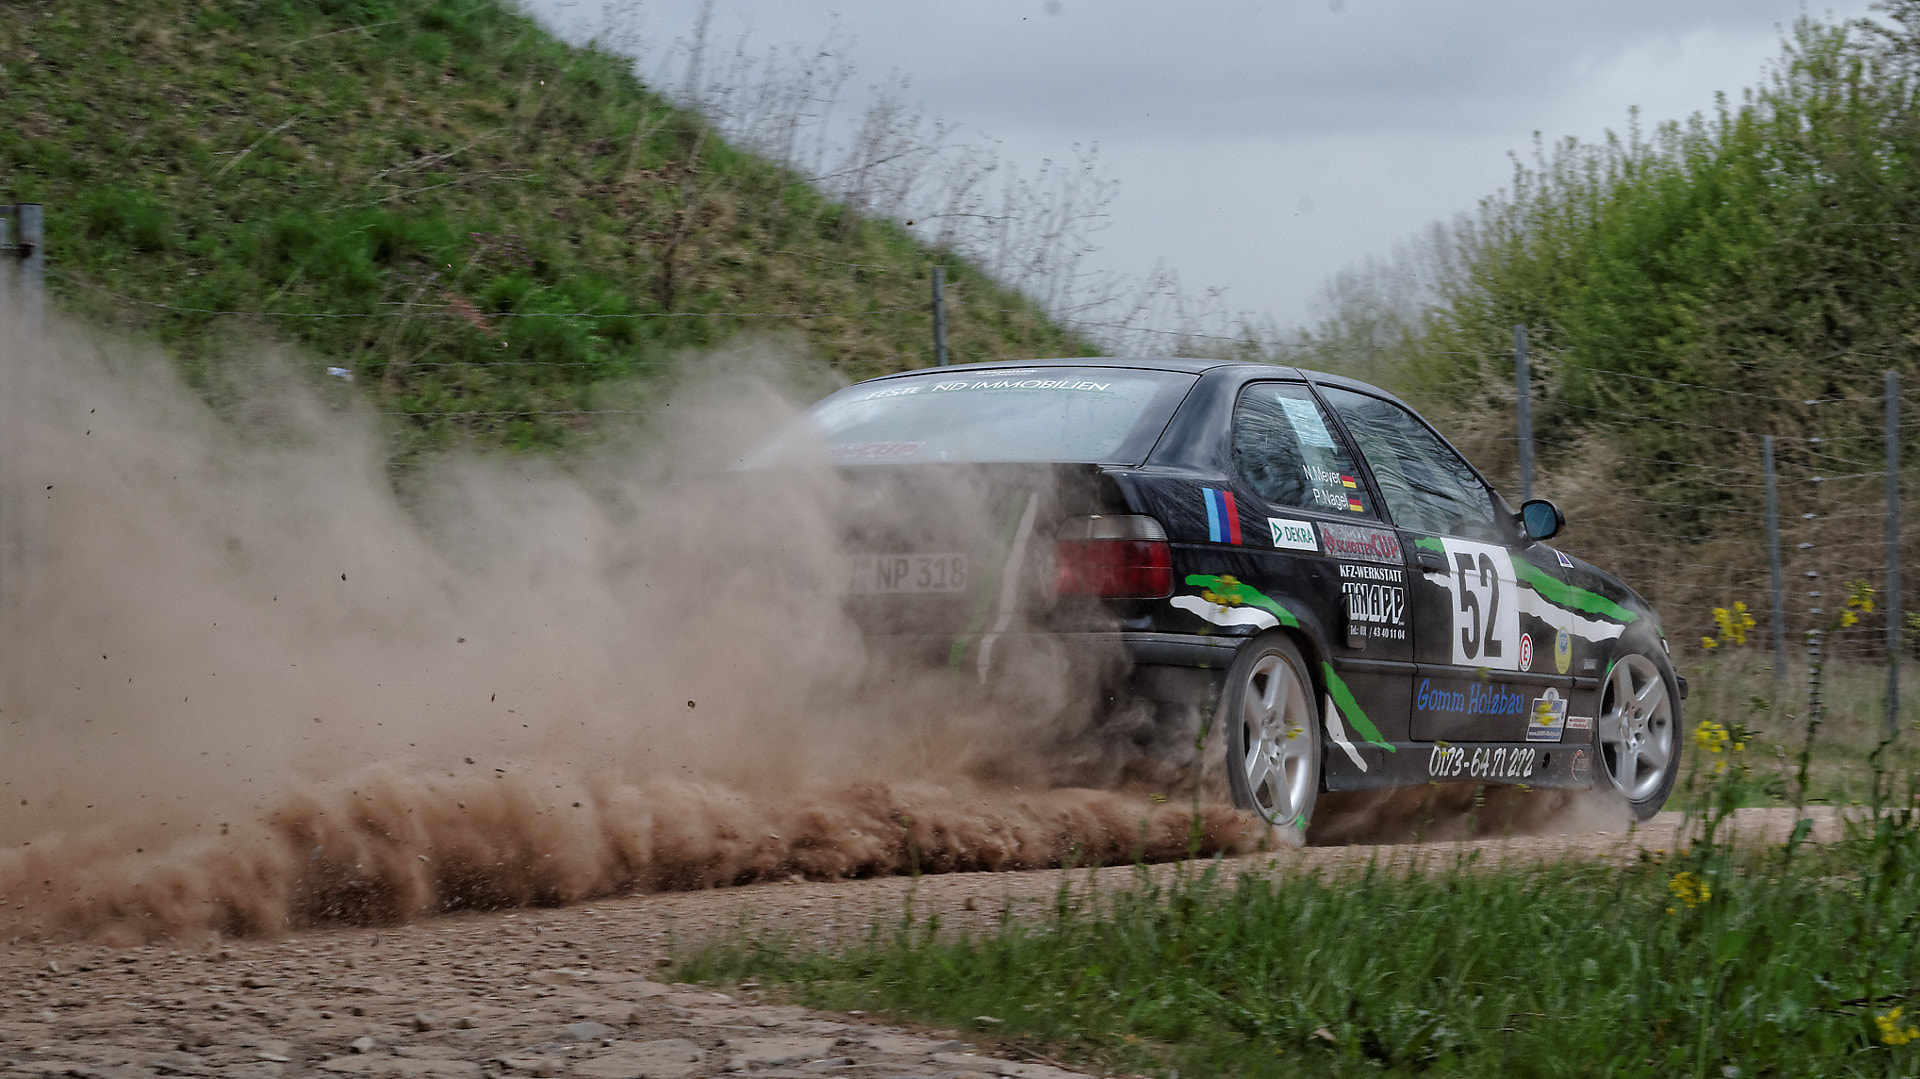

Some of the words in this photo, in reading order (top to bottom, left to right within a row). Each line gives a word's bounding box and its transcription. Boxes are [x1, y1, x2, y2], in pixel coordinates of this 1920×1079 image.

[970, 379, 1111, 392] IMMOBILIEN
[1302, 464, 1341, 486] N.Meyer
[1283, 526, 1315, 544] DEKRA
[916, 557, 964, 589] 318
[1339, 564, 1402, 583] KFZ-WERKSTATT
[1453, 552, 1502, 660] 52
[1417, 678, 1465, 712] Gomm
[1467, 681, 1525, 715] Holzbau
